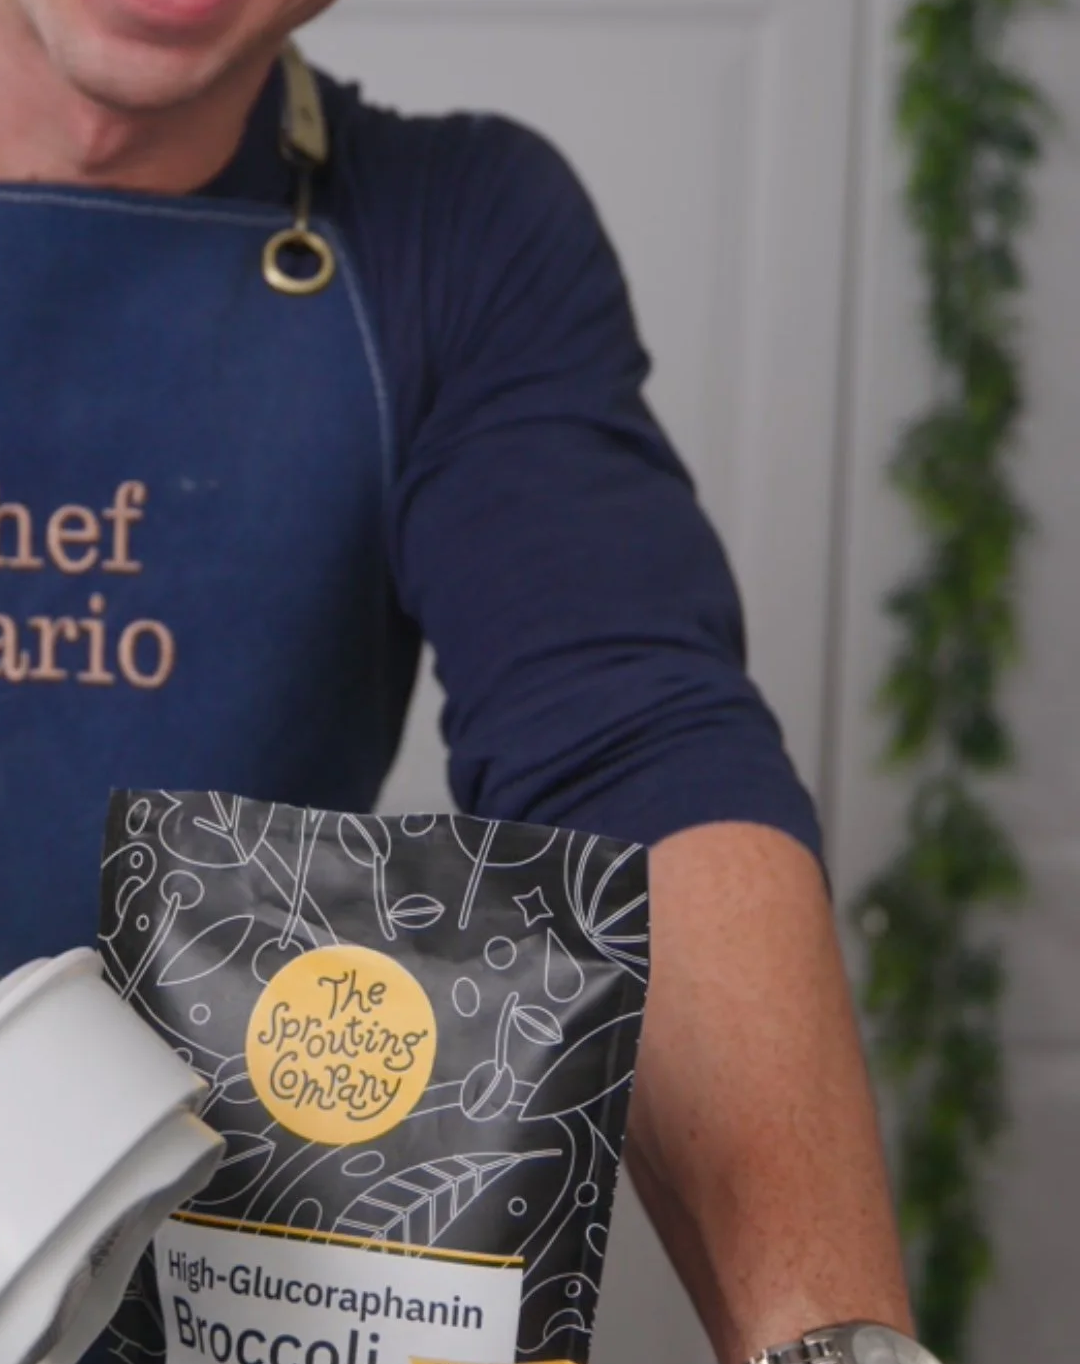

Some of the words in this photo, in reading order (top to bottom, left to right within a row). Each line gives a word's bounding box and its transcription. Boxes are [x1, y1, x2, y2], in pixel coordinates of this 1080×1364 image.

[317, 968, 387, 1020] The
[258, 1001, 429, 1072] Sprouting
[270, 1050, 402, 1122] Company
[168, 1249, 484, 1329] High-Glucoraphanin
